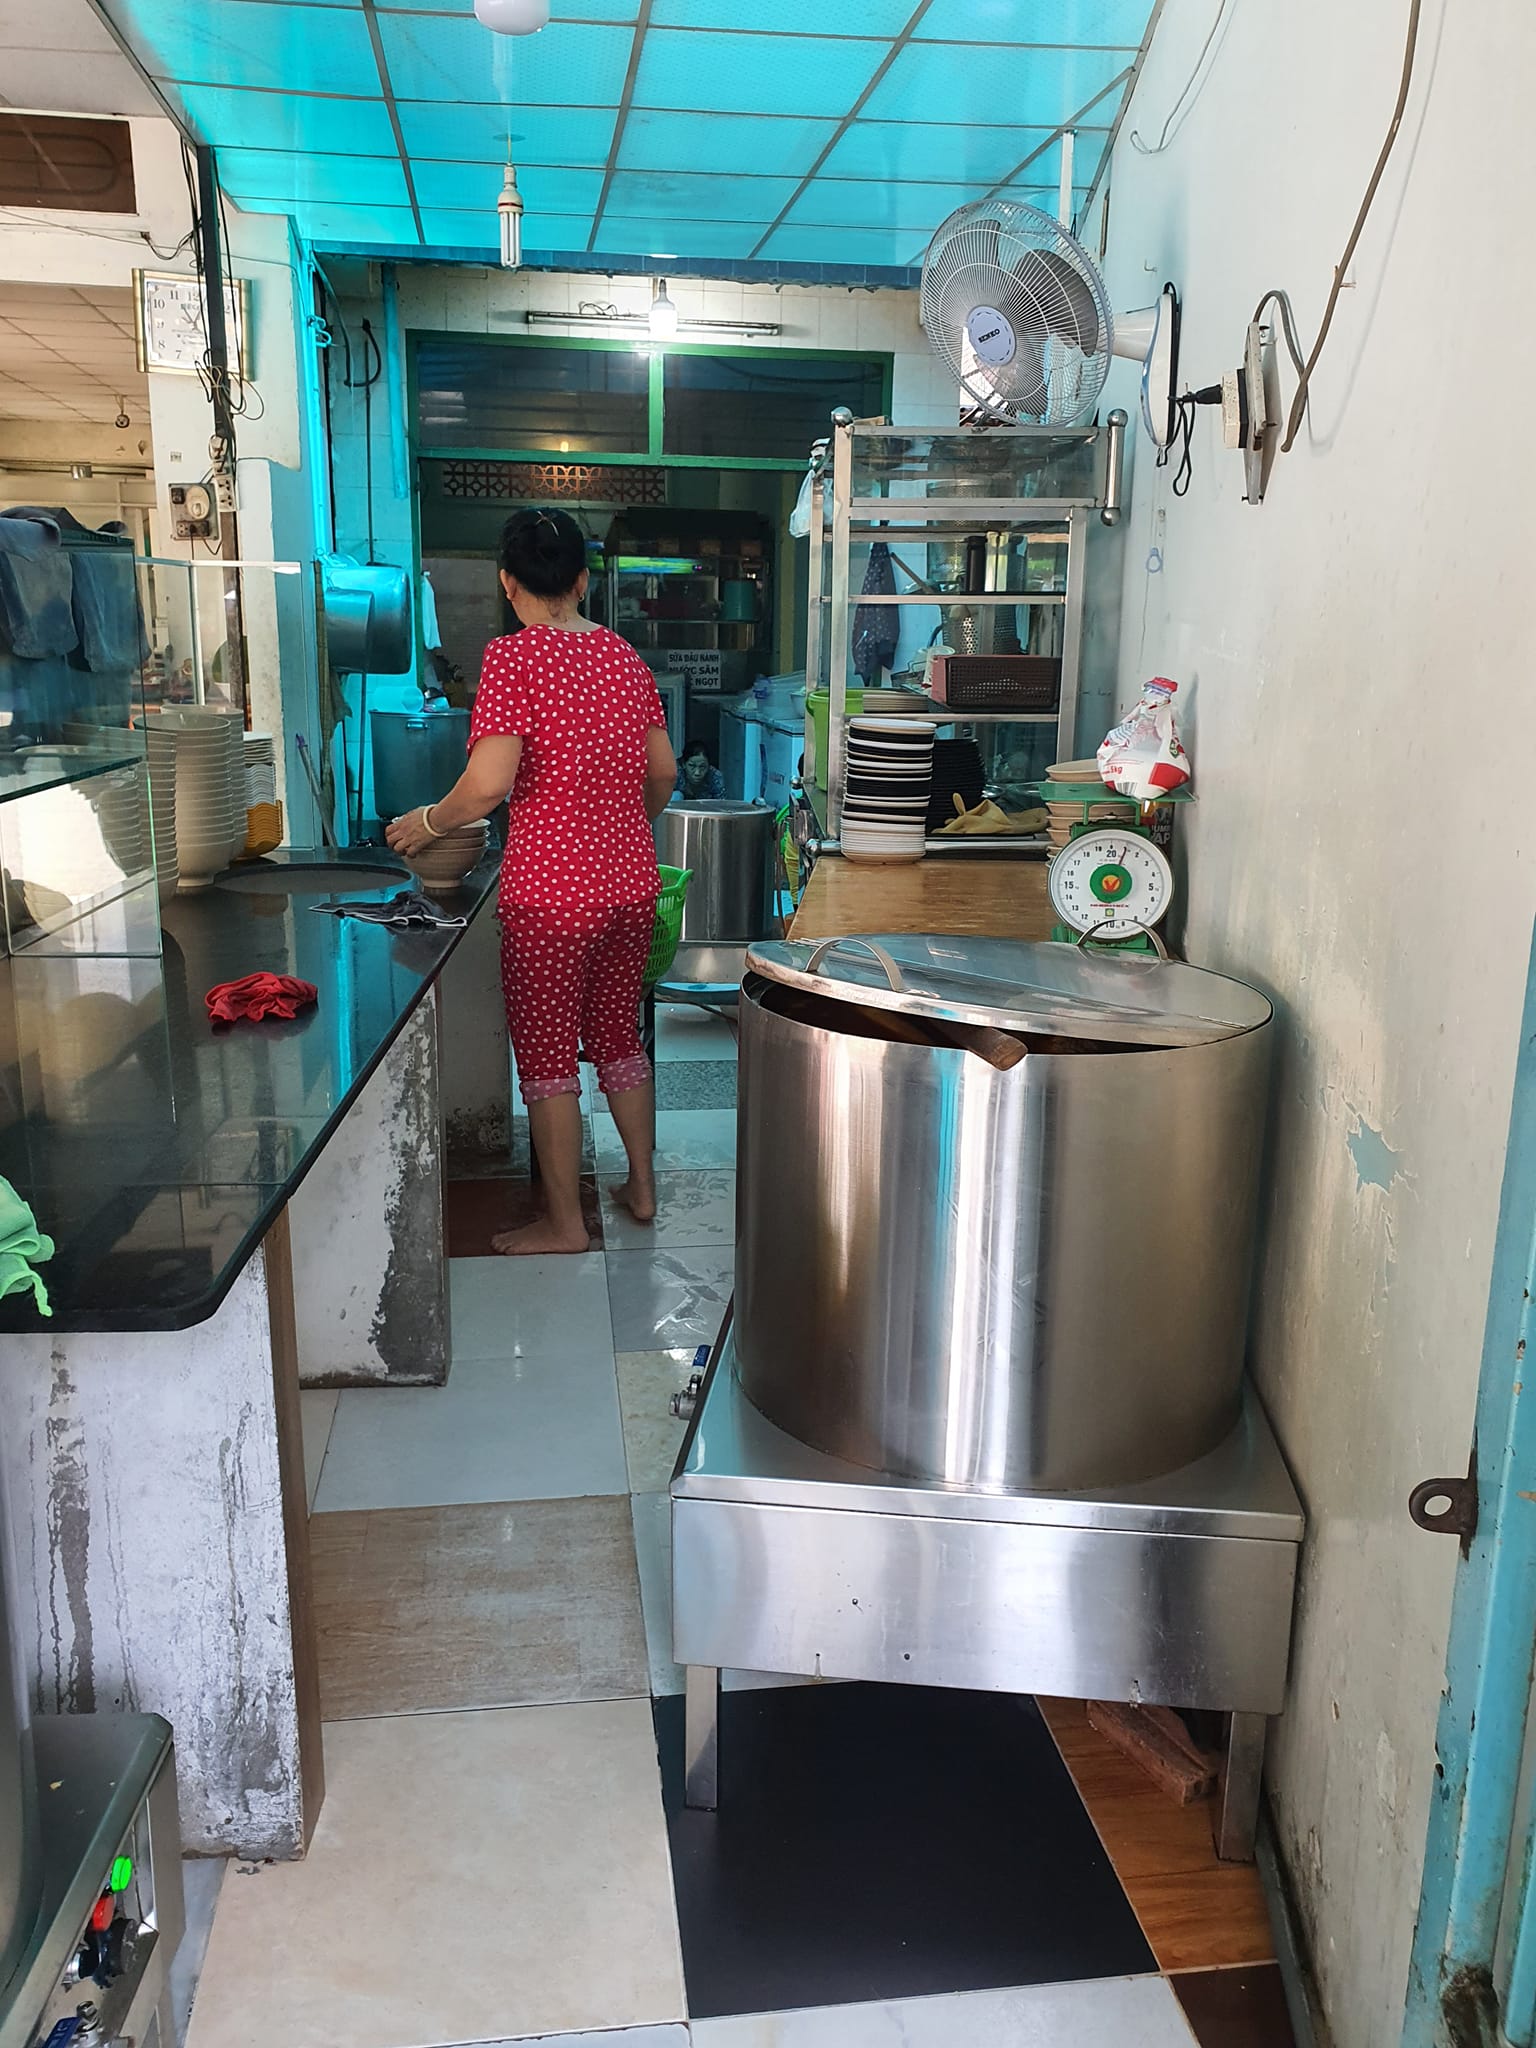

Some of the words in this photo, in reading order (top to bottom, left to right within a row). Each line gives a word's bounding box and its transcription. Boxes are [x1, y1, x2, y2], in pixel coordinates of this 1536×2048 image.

[169, 290, 179, 300] 11
[153, 298, 166, 309] 10
[1106, 850, 1117, 858] 20
[1064, 881, 1074, 889] 15
[1148, 883, 1154, 891] 5
